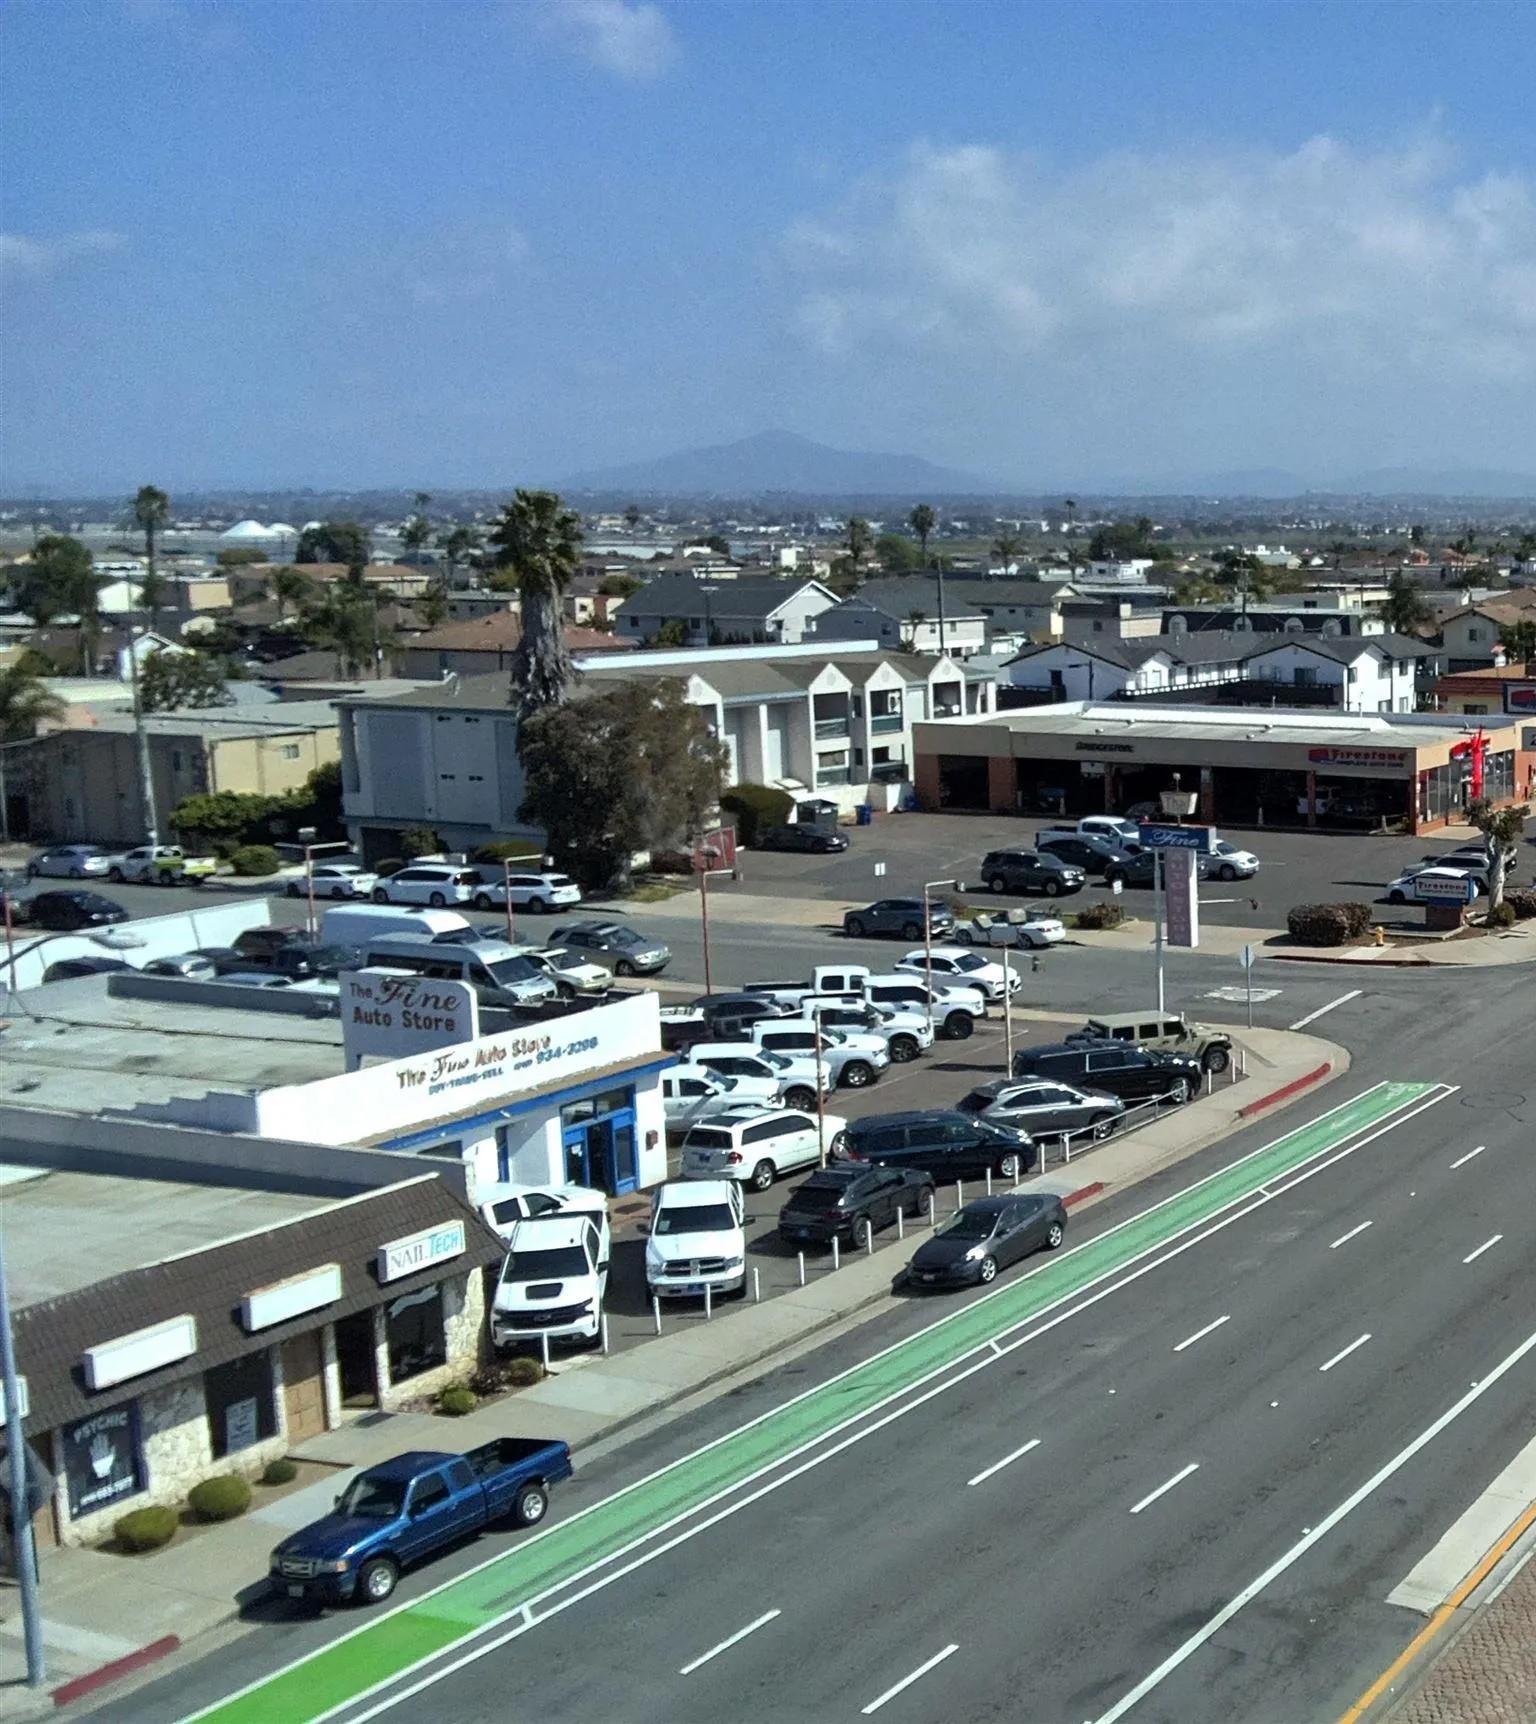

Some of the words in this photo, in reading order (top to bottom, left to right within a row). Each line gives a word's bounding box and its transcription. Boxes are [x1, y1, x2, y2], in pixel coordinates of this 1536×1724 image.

[1149, 829, 1200, 846] Fine
[1418, 882, 1467, 890] Firestone
[351, 983, 373, 998] The
[374, 979, 462, 1012] Fine
[353, 1006, 392, 1027] Auto
[402, 1010, 456, 1032] Store
[396, 1068, 426, 1090] The
[390, 1245, 428, 1272] NAIL
[428, 1231, 459, 1258] TECH
